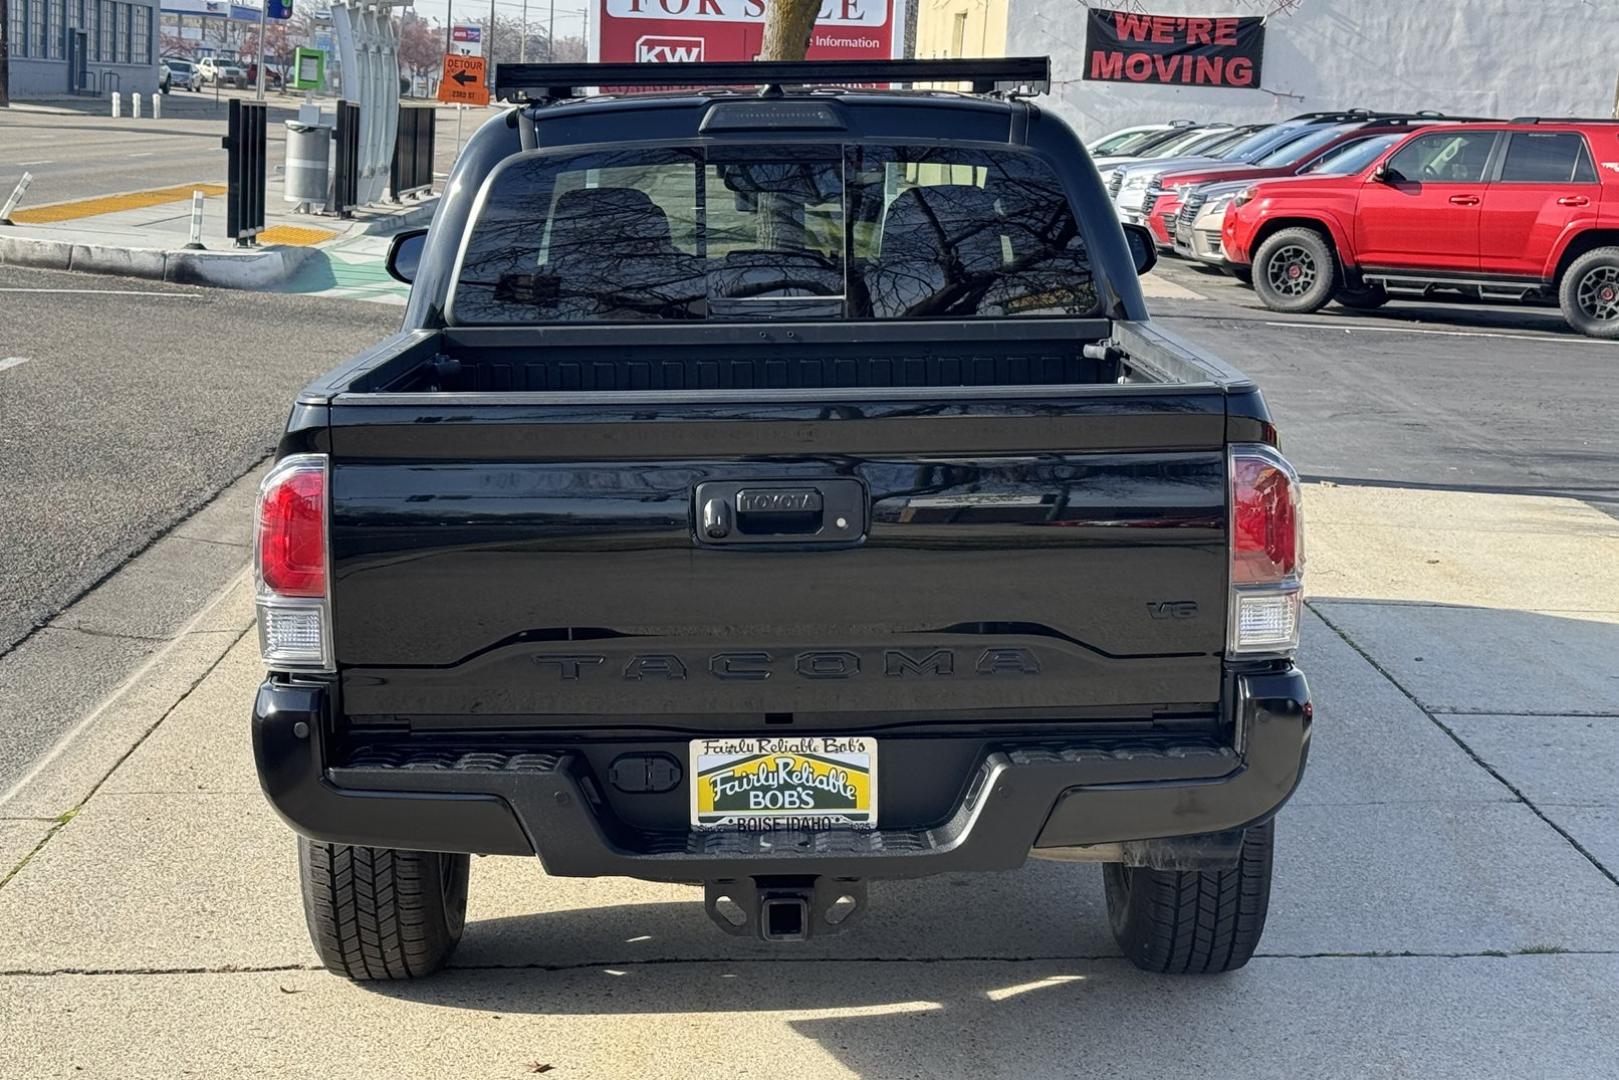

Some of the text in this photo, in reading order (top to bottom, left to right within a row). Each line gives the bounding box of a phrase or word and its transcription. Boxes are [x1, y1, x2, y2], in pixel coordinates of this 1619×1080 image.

[1114, 13, 1240, 46] WE'RE
[816, 36, 880, 49] Information
[640, 45, 701, 63] KW
[447, 59, 483, 70] DETOUR
[1091, 50, 1253, 86] MOVING
[743, 495, 814, 510] TOYOTA
[1147, 600, 1198, 620] V6
[532, 648, 1041, 681] TACOMA
[702, 738, 866, 755] Fairly Reliable Bob's
[710, 757, 857, 802] Fairly Reliable
[749, 788, 815, 809] BOB'S
[737, 817, 782, 832] BOISE
[787, 816, 832, 831] IDAHO
